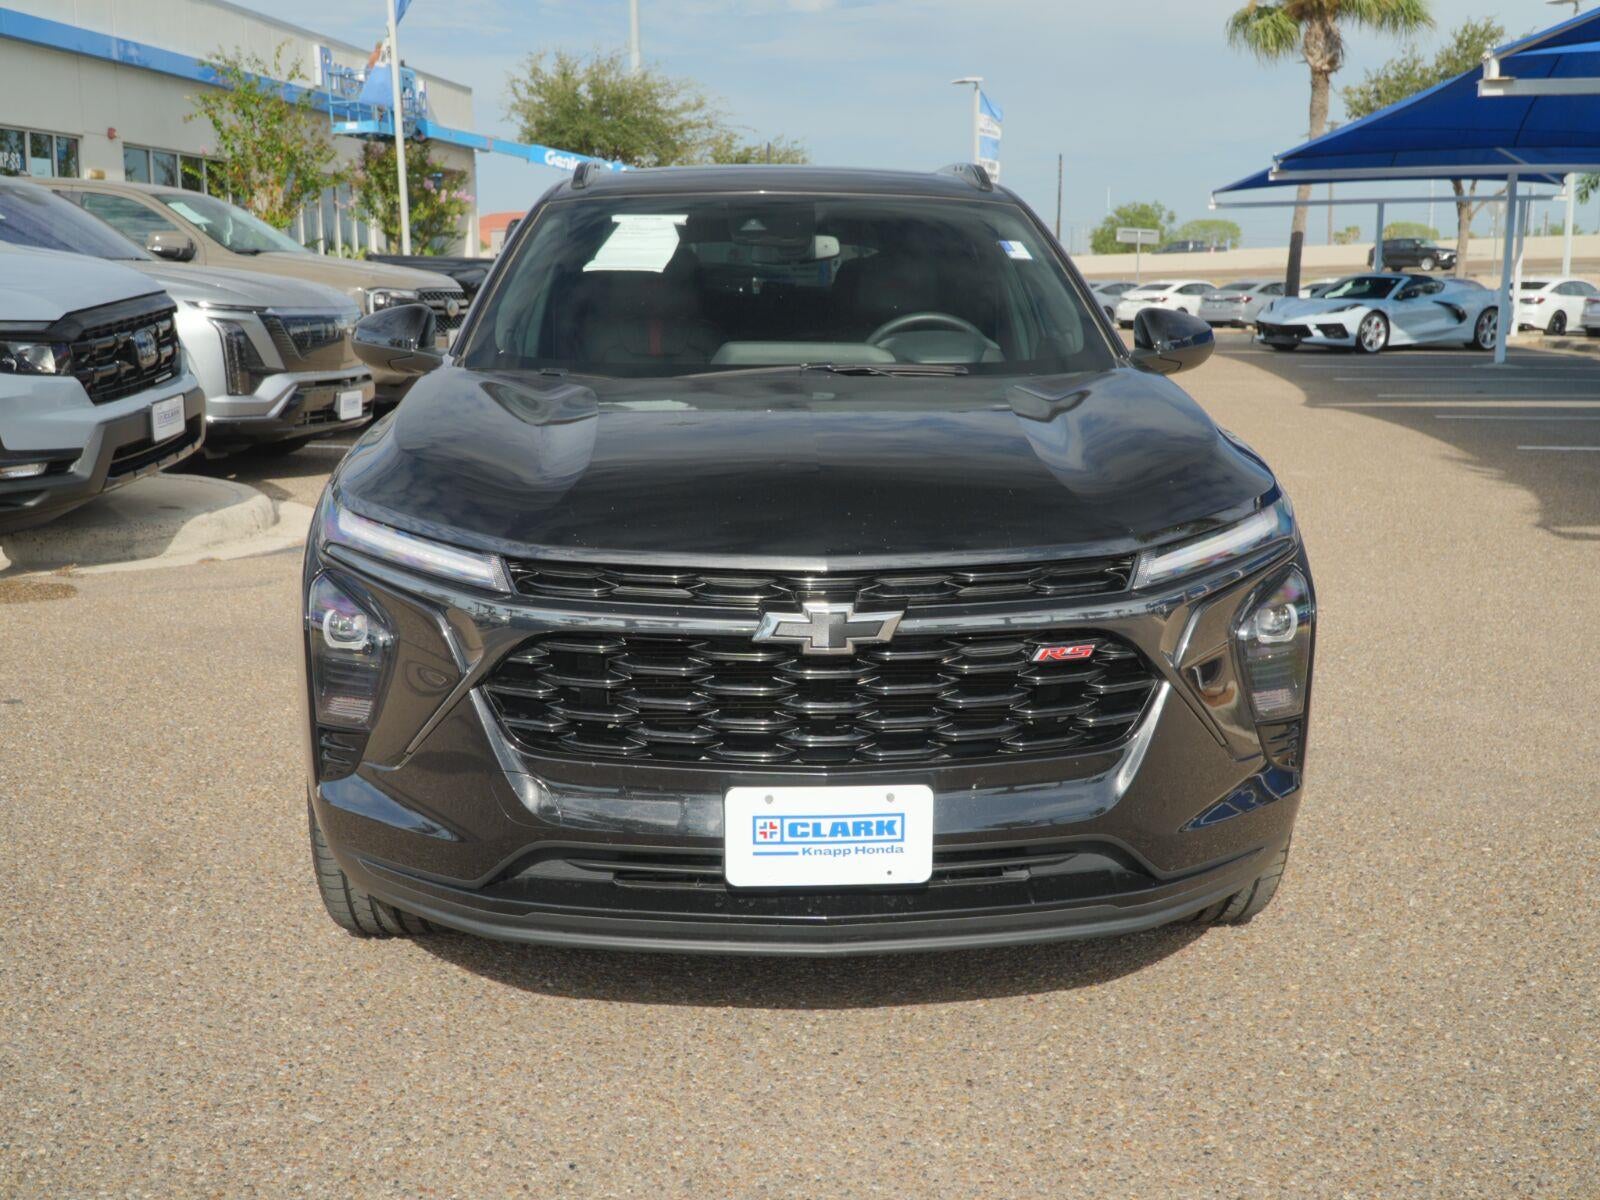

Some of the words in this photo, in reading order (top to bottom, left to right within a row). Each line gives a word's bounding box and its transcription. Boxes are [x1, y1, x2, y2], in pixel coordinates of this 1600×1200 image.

[1033, 644, 1095, 661] RS
[787, 820, 897, 838] CLARK
[802, 847, 852, 857] Knapp
[854, 845, 904, 856] Honda
